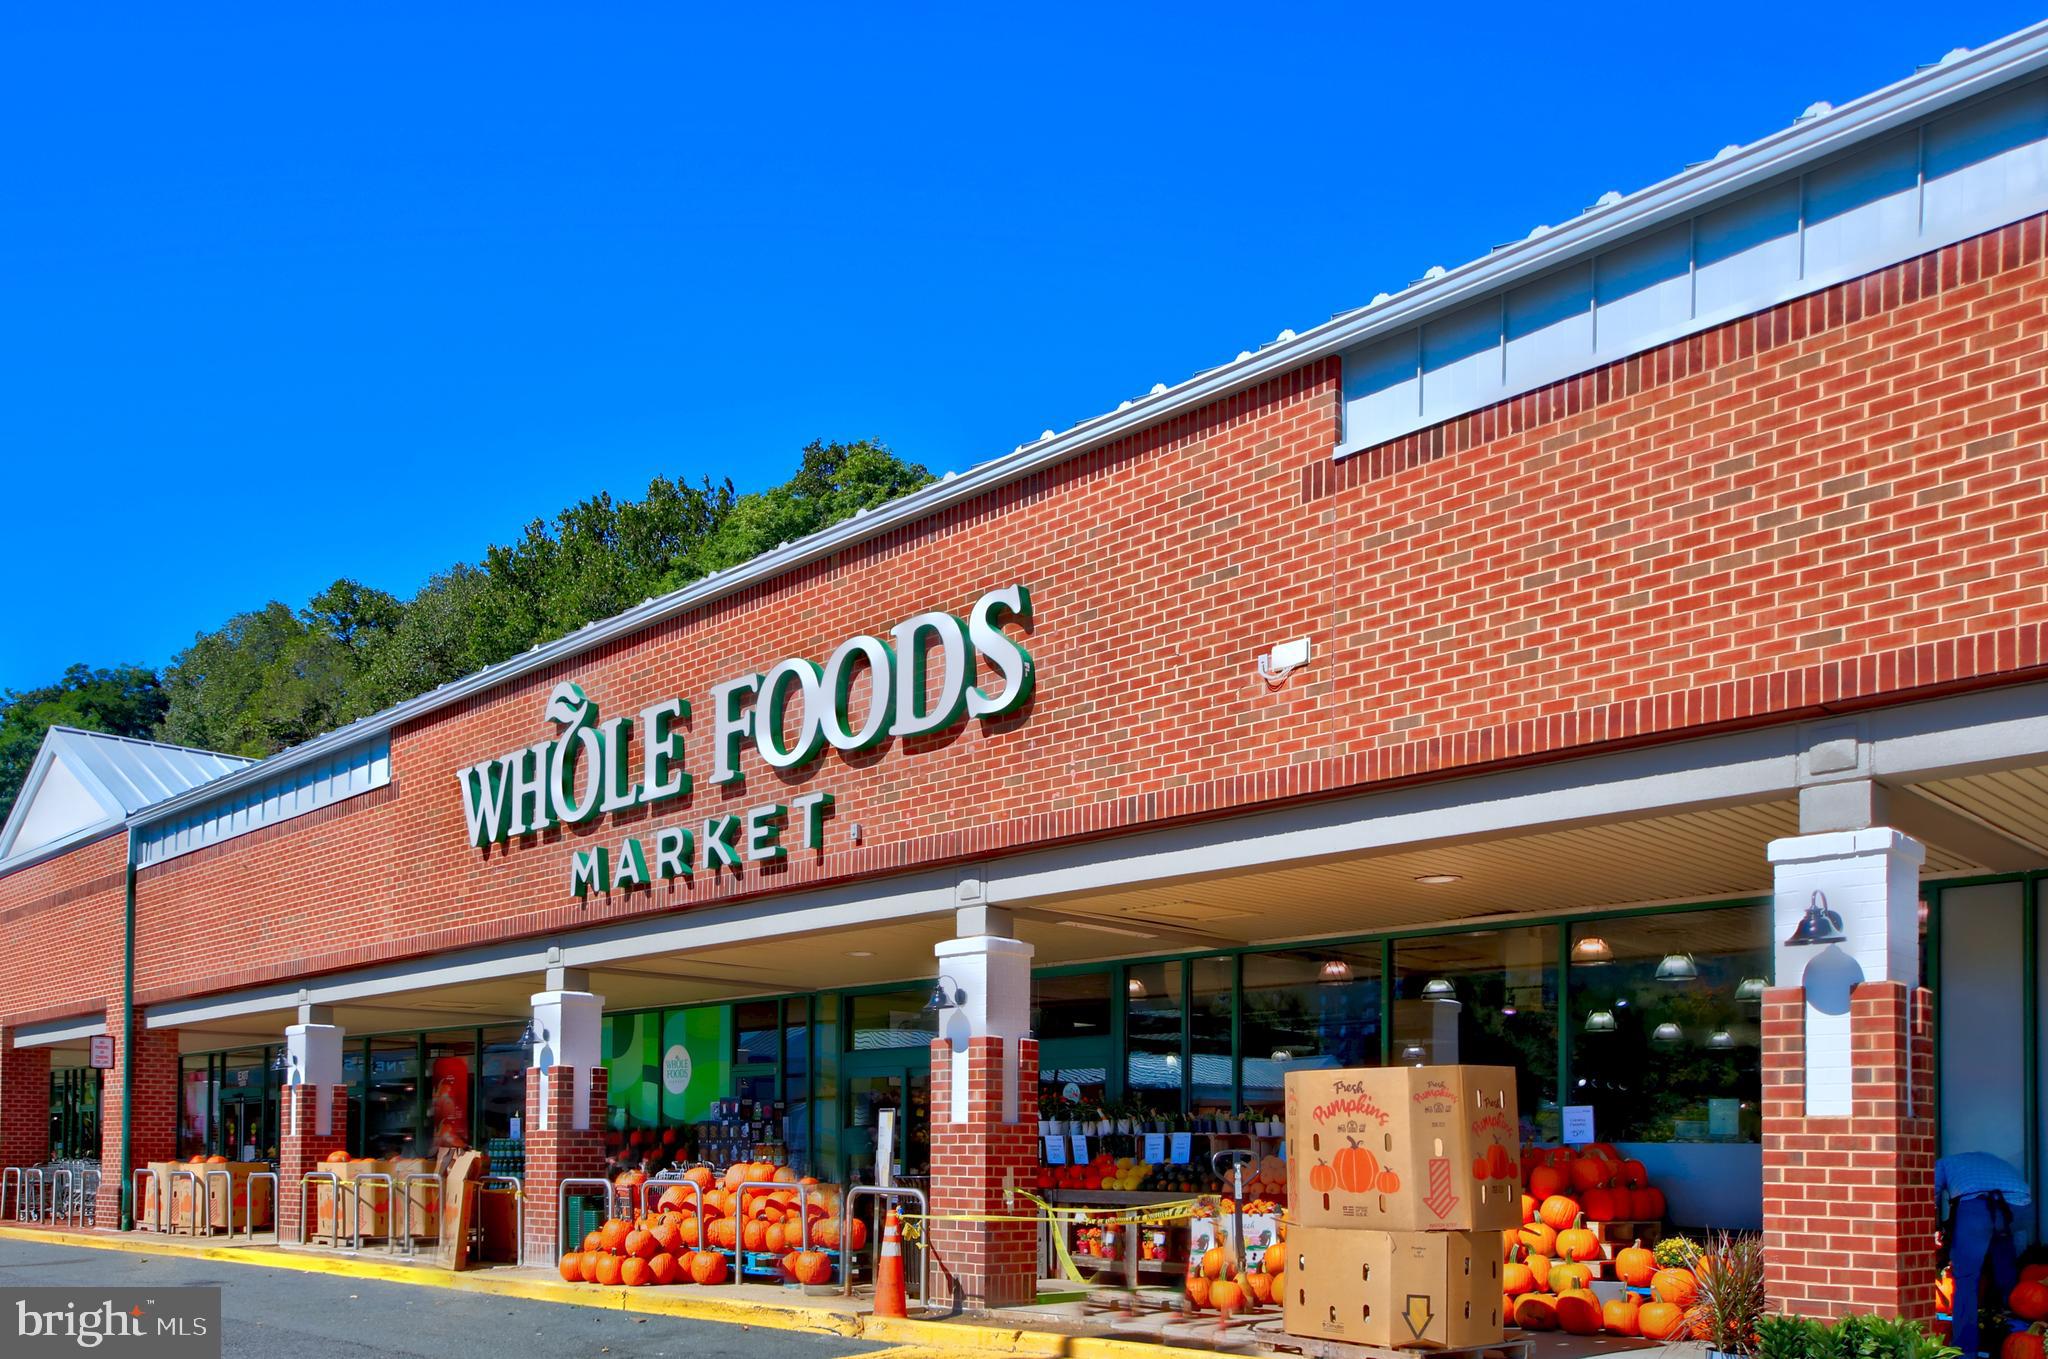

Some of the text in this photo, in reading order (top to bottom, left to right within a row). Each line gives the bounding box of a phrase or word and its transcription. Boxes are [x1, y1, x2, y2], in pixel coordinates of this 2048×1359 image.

[456, 584, 1034, 848] WHOLE FOODS
[571, 792, 834, 896] MARKET
[666, 1059, 688, 1069] WHOLE
[667, 1069, 688, 1078] FOODS
[1333, 1081, 1365, 1094] Fresh
[1313, 1094, 1389, 1126] Pumpkins
